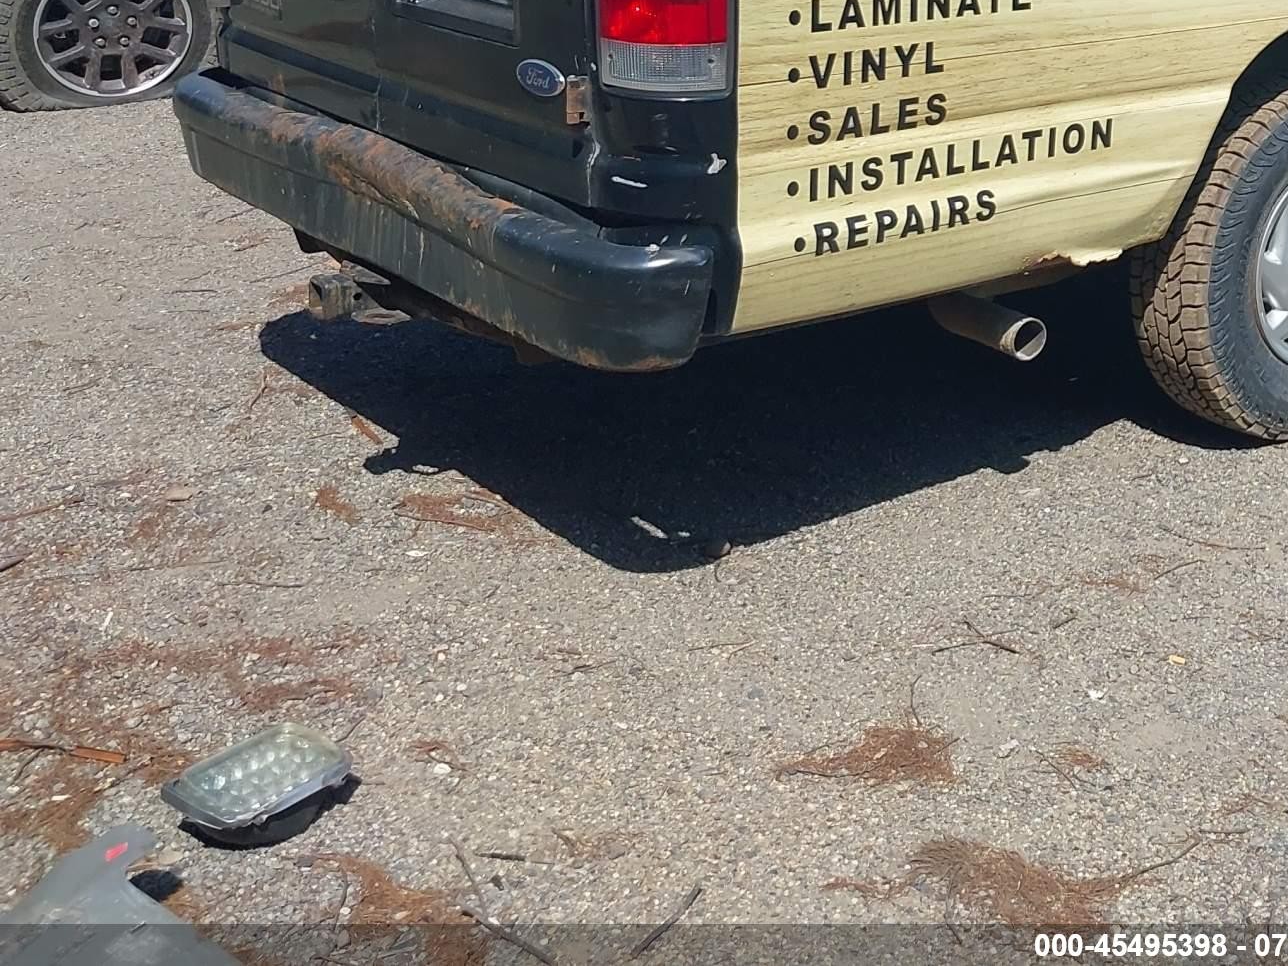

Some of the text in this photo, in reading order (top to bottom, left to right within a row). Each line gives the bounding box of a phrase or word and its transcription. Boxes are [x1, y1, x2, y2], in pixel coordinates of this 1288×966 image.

[807, 40, 945, 90] VINYL
[806, 92, 948, 147] SALES
[808, 117, 1114, 203] INSTALLATION
[813, 189, 997, 258] REPAIRS
